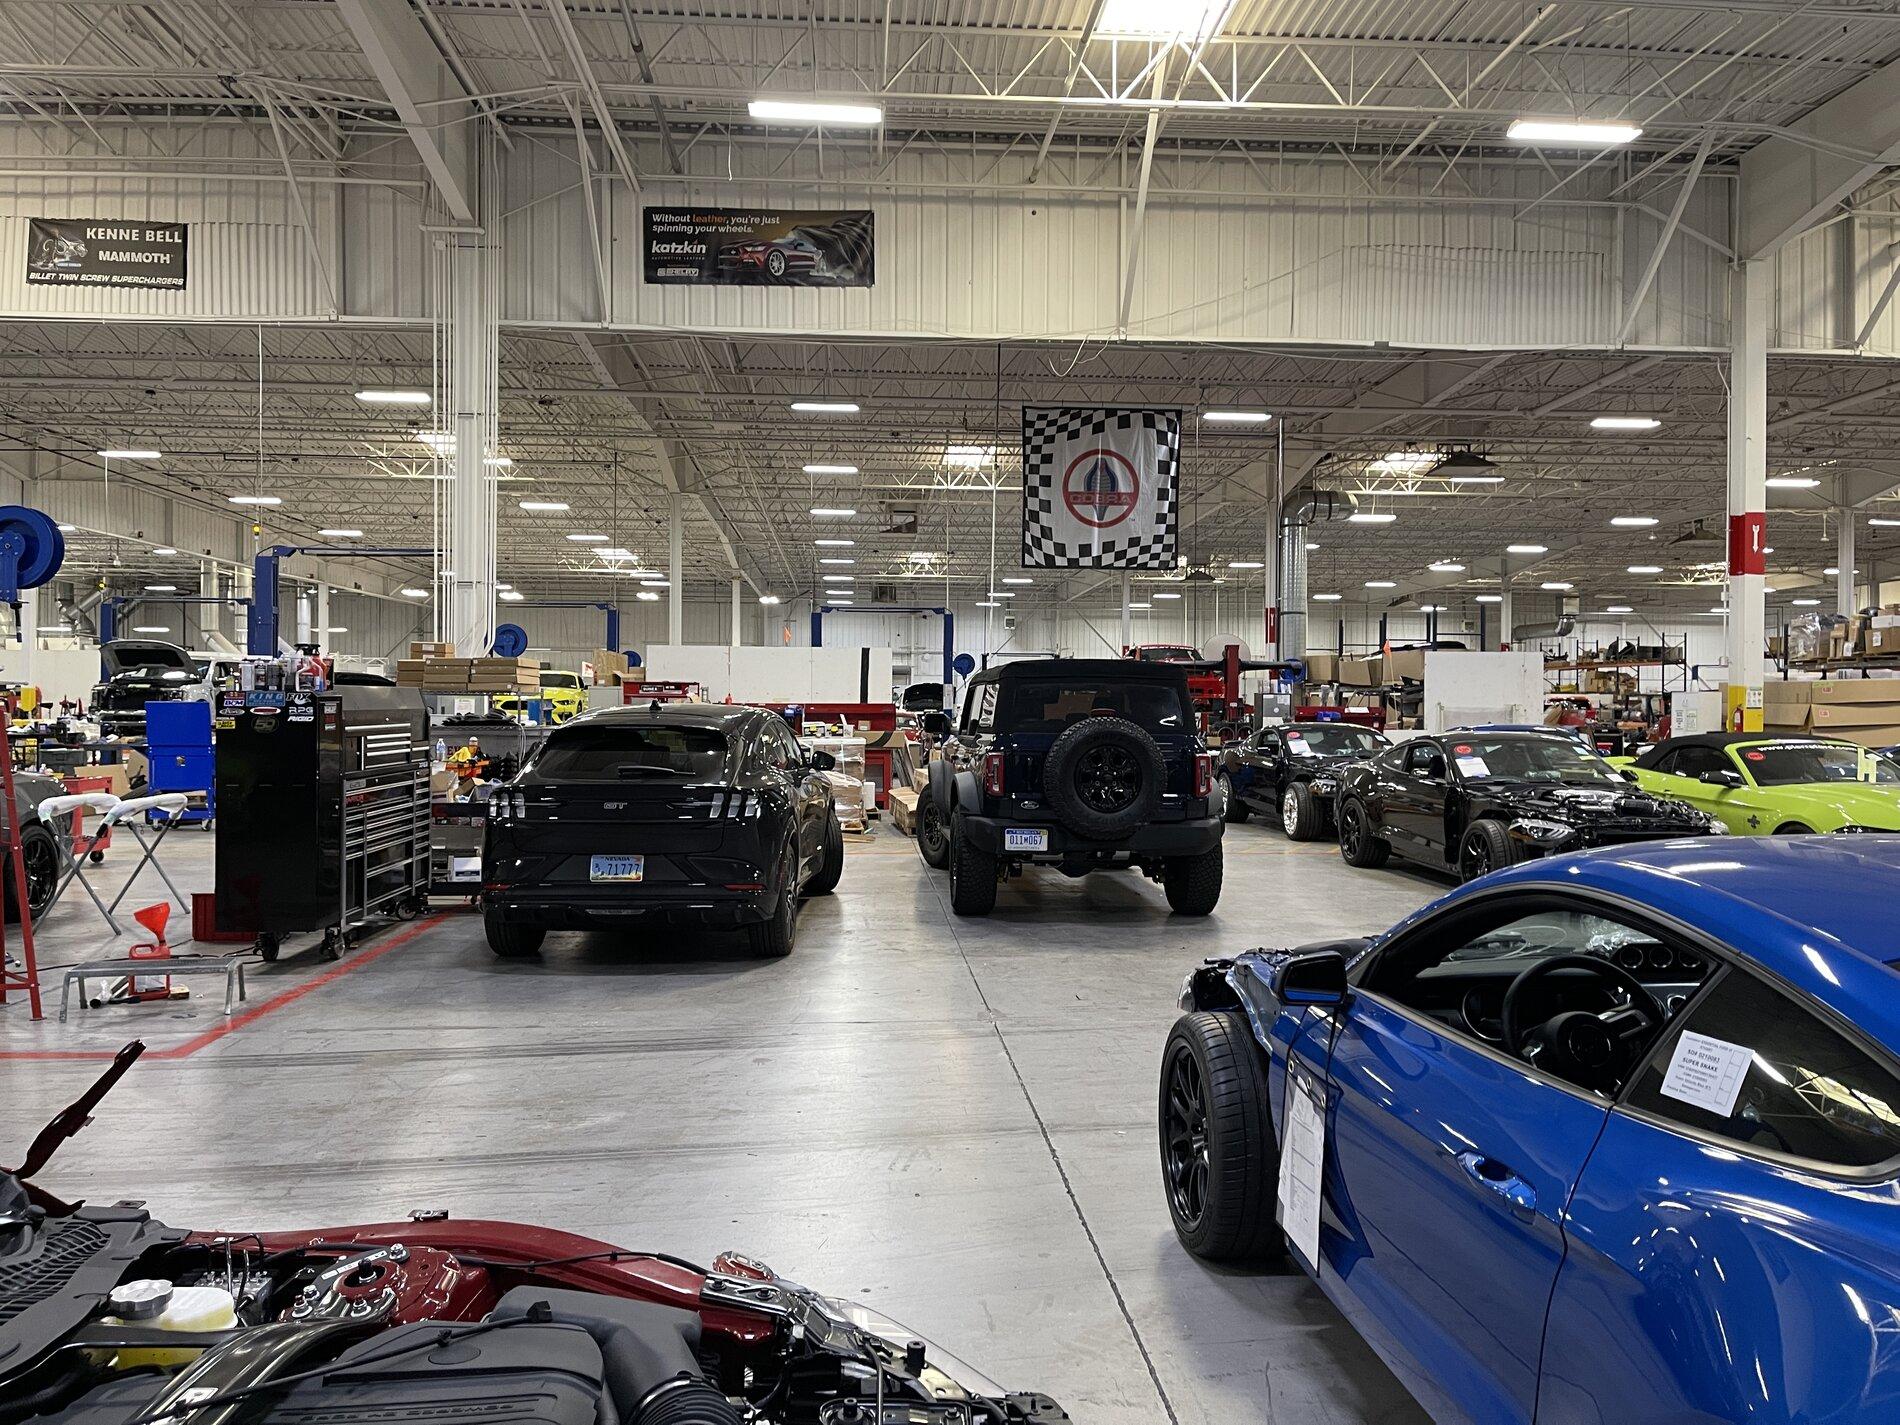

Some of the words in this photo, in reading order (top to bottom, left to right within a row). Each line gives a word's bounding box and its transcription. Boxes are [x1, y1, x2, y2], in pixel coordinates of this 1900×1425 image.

[652, 213, 691, 223] Without
[692, 214, 729, 224] leather,
[730, 214, 760, 225] you're
[760, 216, 780, 226] just
[86, 227, 140, 241] KENNE
[145, 230, 183, 243] BELL
[652, 223, 693, 234] spinning
[694, 225, 717, 234] your
[717, 224, 754, 233] wheels.
[651, 239, 707, 254] katzkin
[98, 250, 171, 264] MAMMOTH
[29, 272, 57, 280] BILLET
[58, 273, 80, 281] TWIN
[80, 274, 110, 282] SCREW
[111, 275, 184, 286] SUPERCHARGERS
[1069, 493, 1130, 505] COBRA
[248, 692, 284, 700] KING
[607, 863, 640, 876] 71777
[1682, 1057, 1700, 1067] SUPER
[1700, 1062, 1718, 1072] SNAKE
